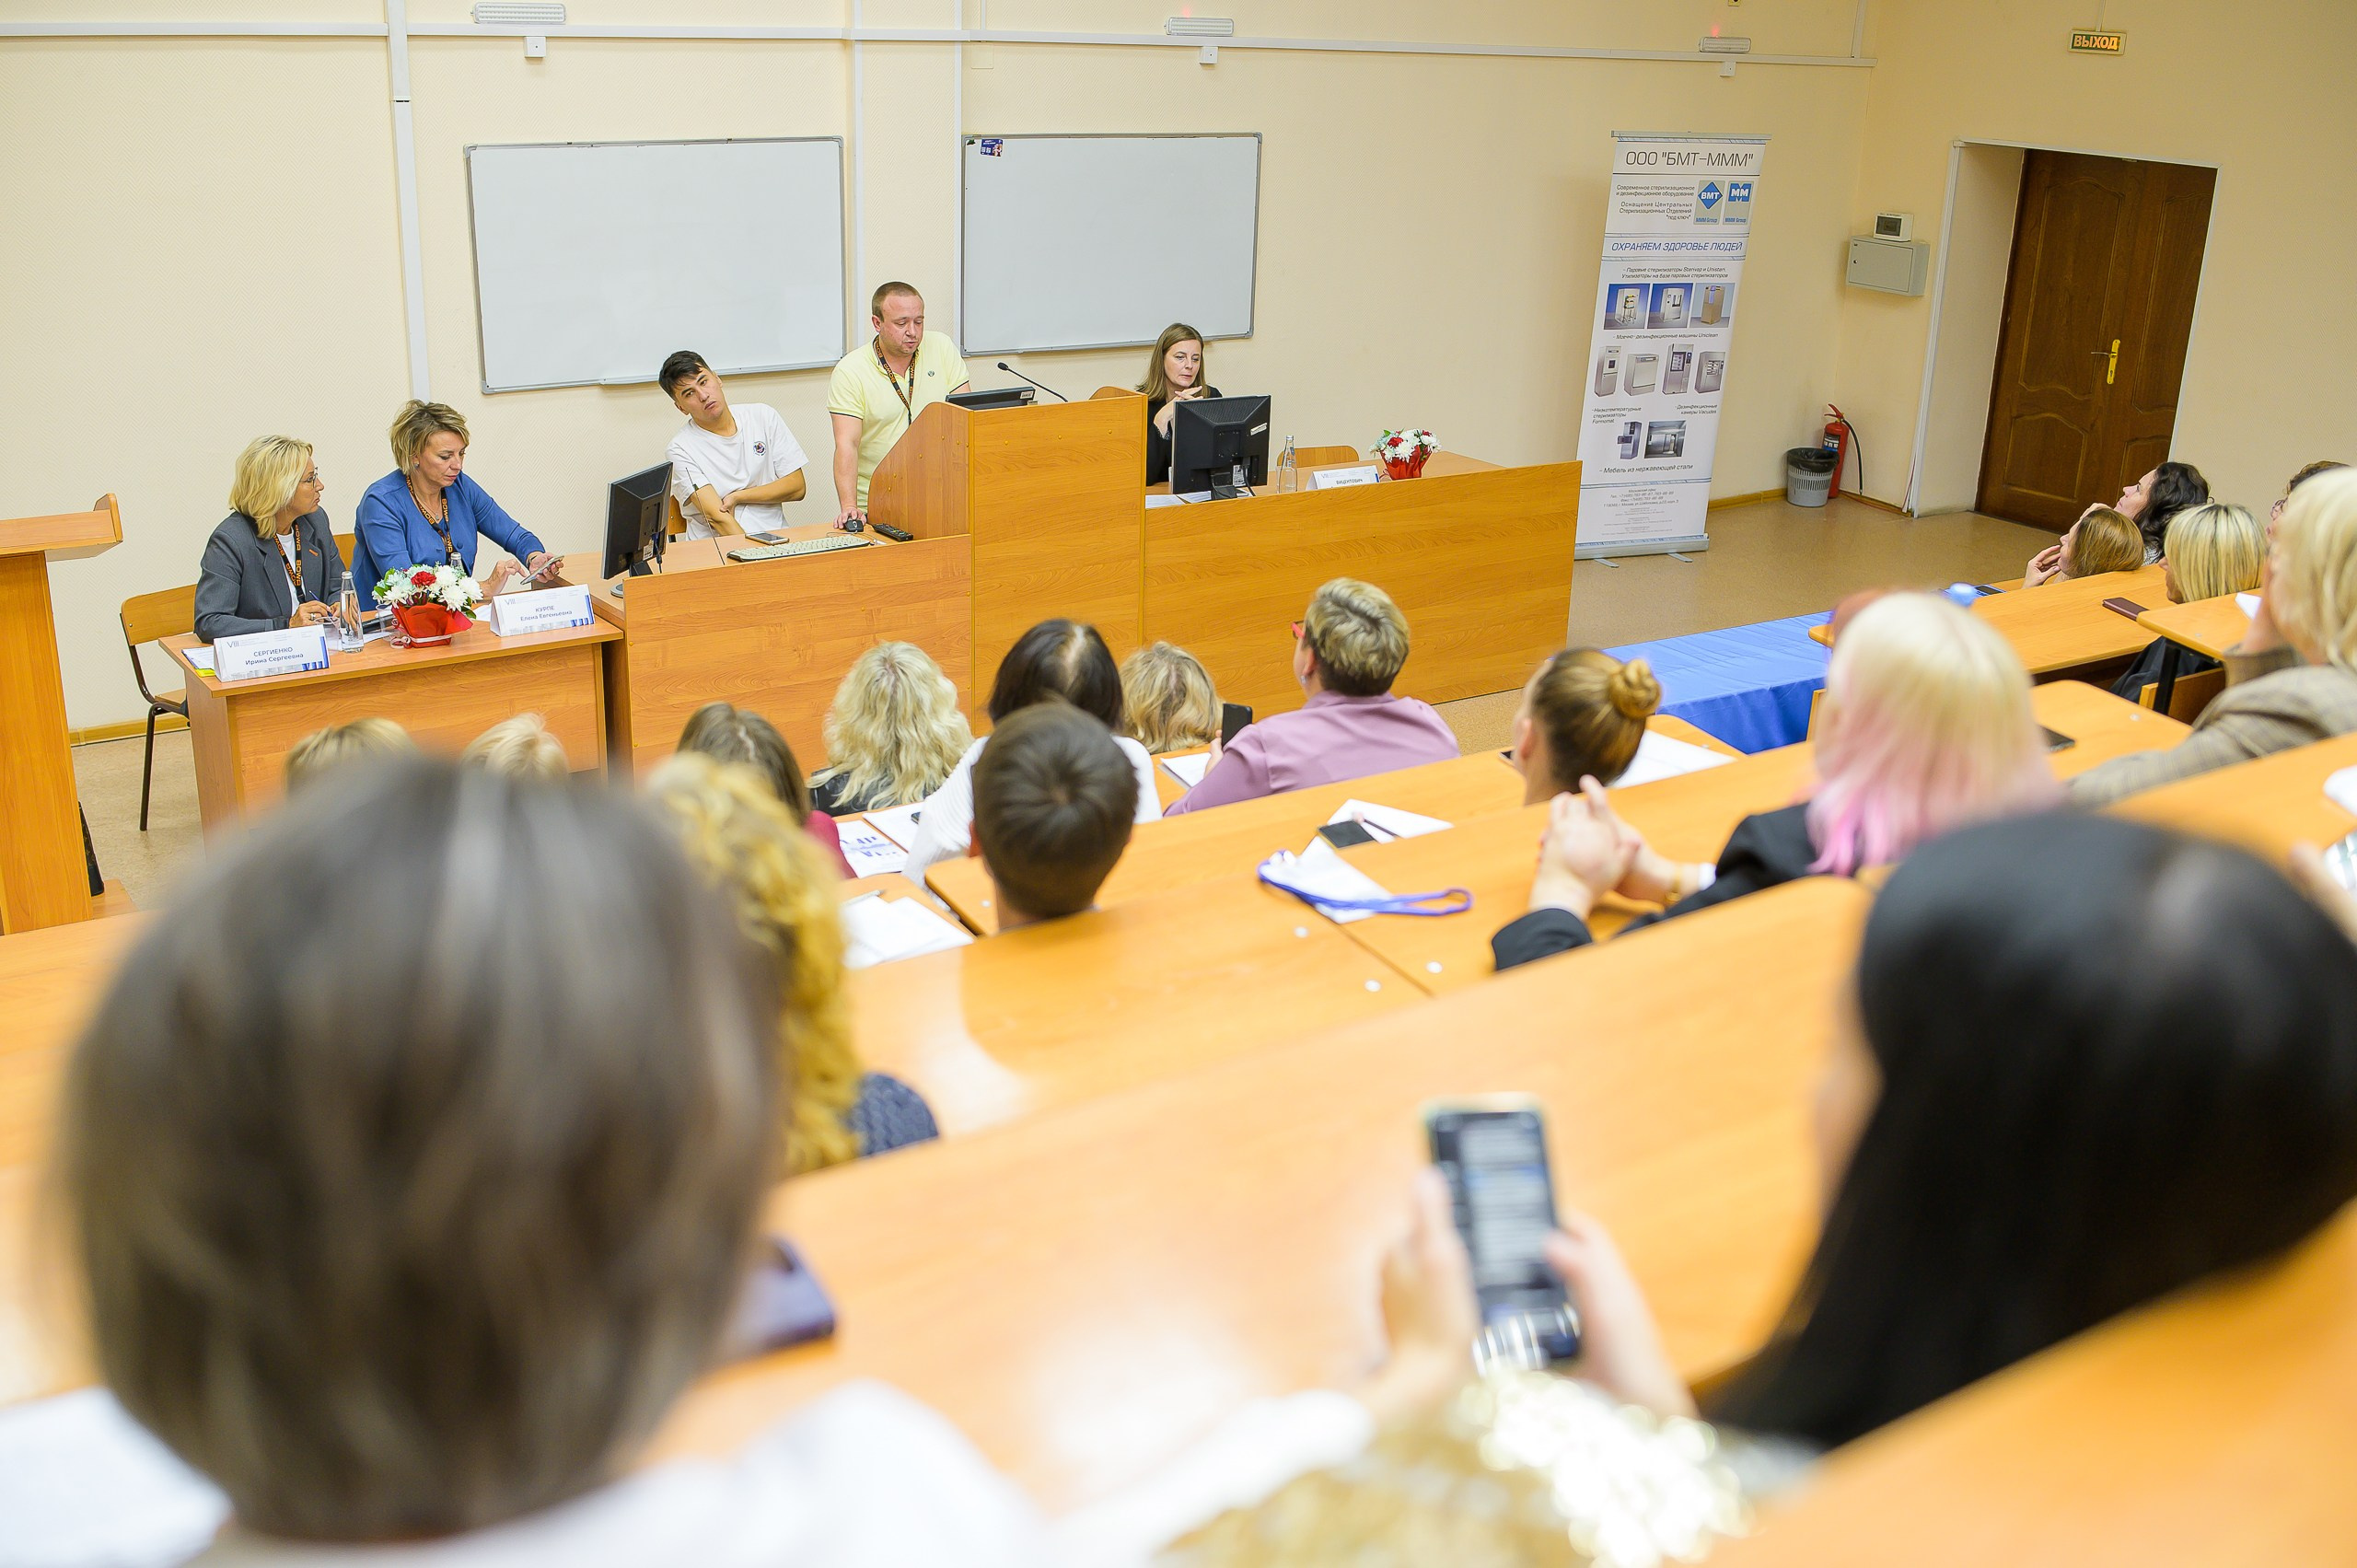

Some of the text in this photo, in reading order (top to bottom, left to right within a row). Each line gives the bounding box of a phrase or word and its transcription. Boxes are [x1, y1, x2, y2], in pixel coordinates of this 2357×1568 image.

[2073, 35, 2119, 50] ВЫХОД
[1626, 151, 1658, 166] ООО
[1611, 241, 1743, 251] ОХРАНЯЕМ ЗДОРОВЬЕ ЛЮДЕЙ
[1604, 466, 1626, 474] Мебель
[1635, 465, 1676, 473] нержавеющей
[539, 610, 573, 619] Евгеньевна
[253, 646, 293, 657] СЕРГИЕНКО
[268, 653, 304, 663] Сергеевна
